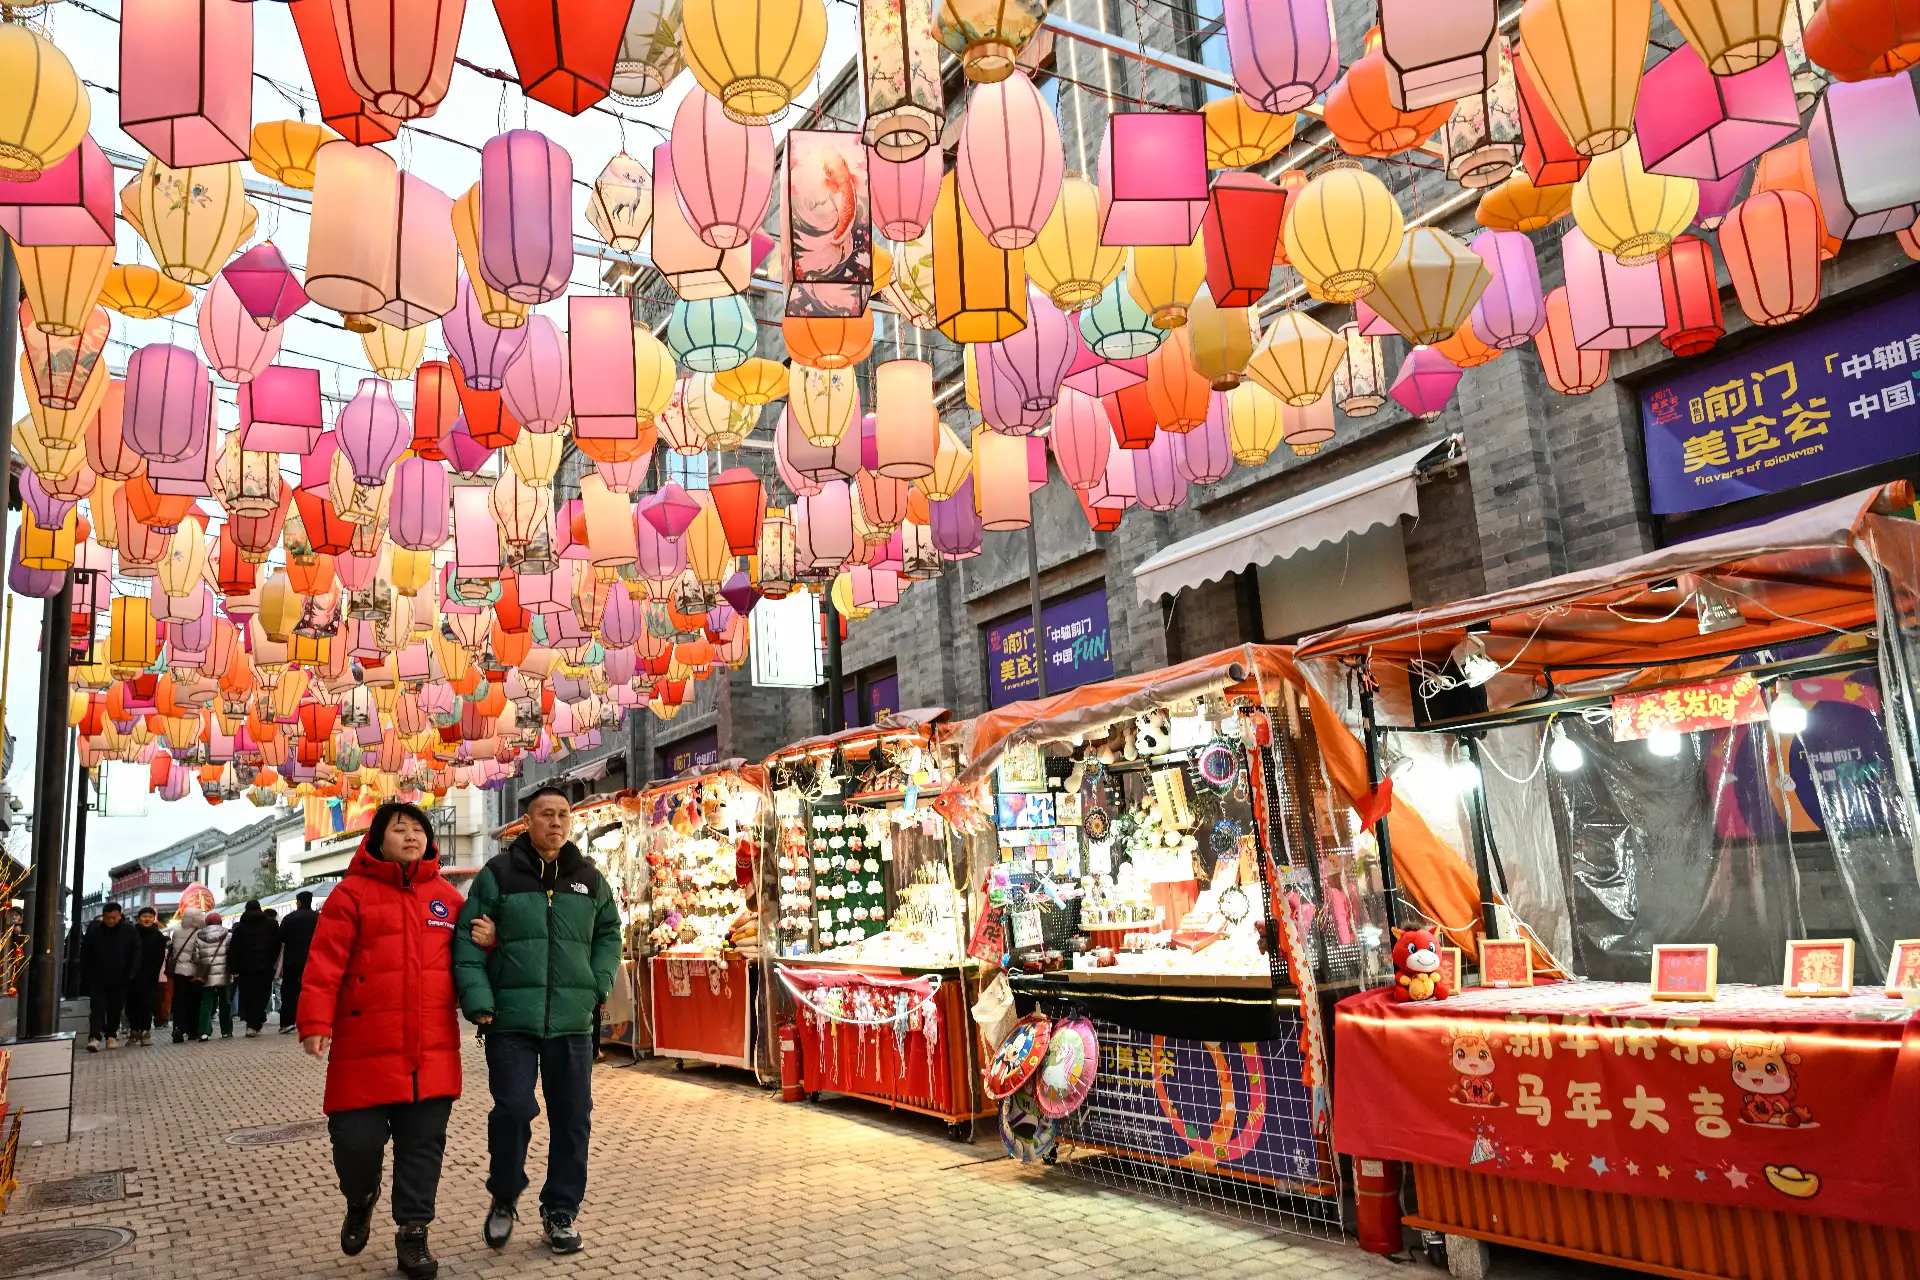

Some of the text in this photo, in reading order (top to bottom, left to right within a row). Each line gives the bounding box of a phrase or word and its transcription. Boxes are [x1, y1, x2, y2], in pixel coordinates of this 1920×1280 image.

[1703, 361, 1799, 423] 前门
[1636, 689, 1739, 728] 恭喜发财
[1505, 1010, 1715, 1065] 新年快乐
[1516, 1073, 1731, 1138] 马年大吉
